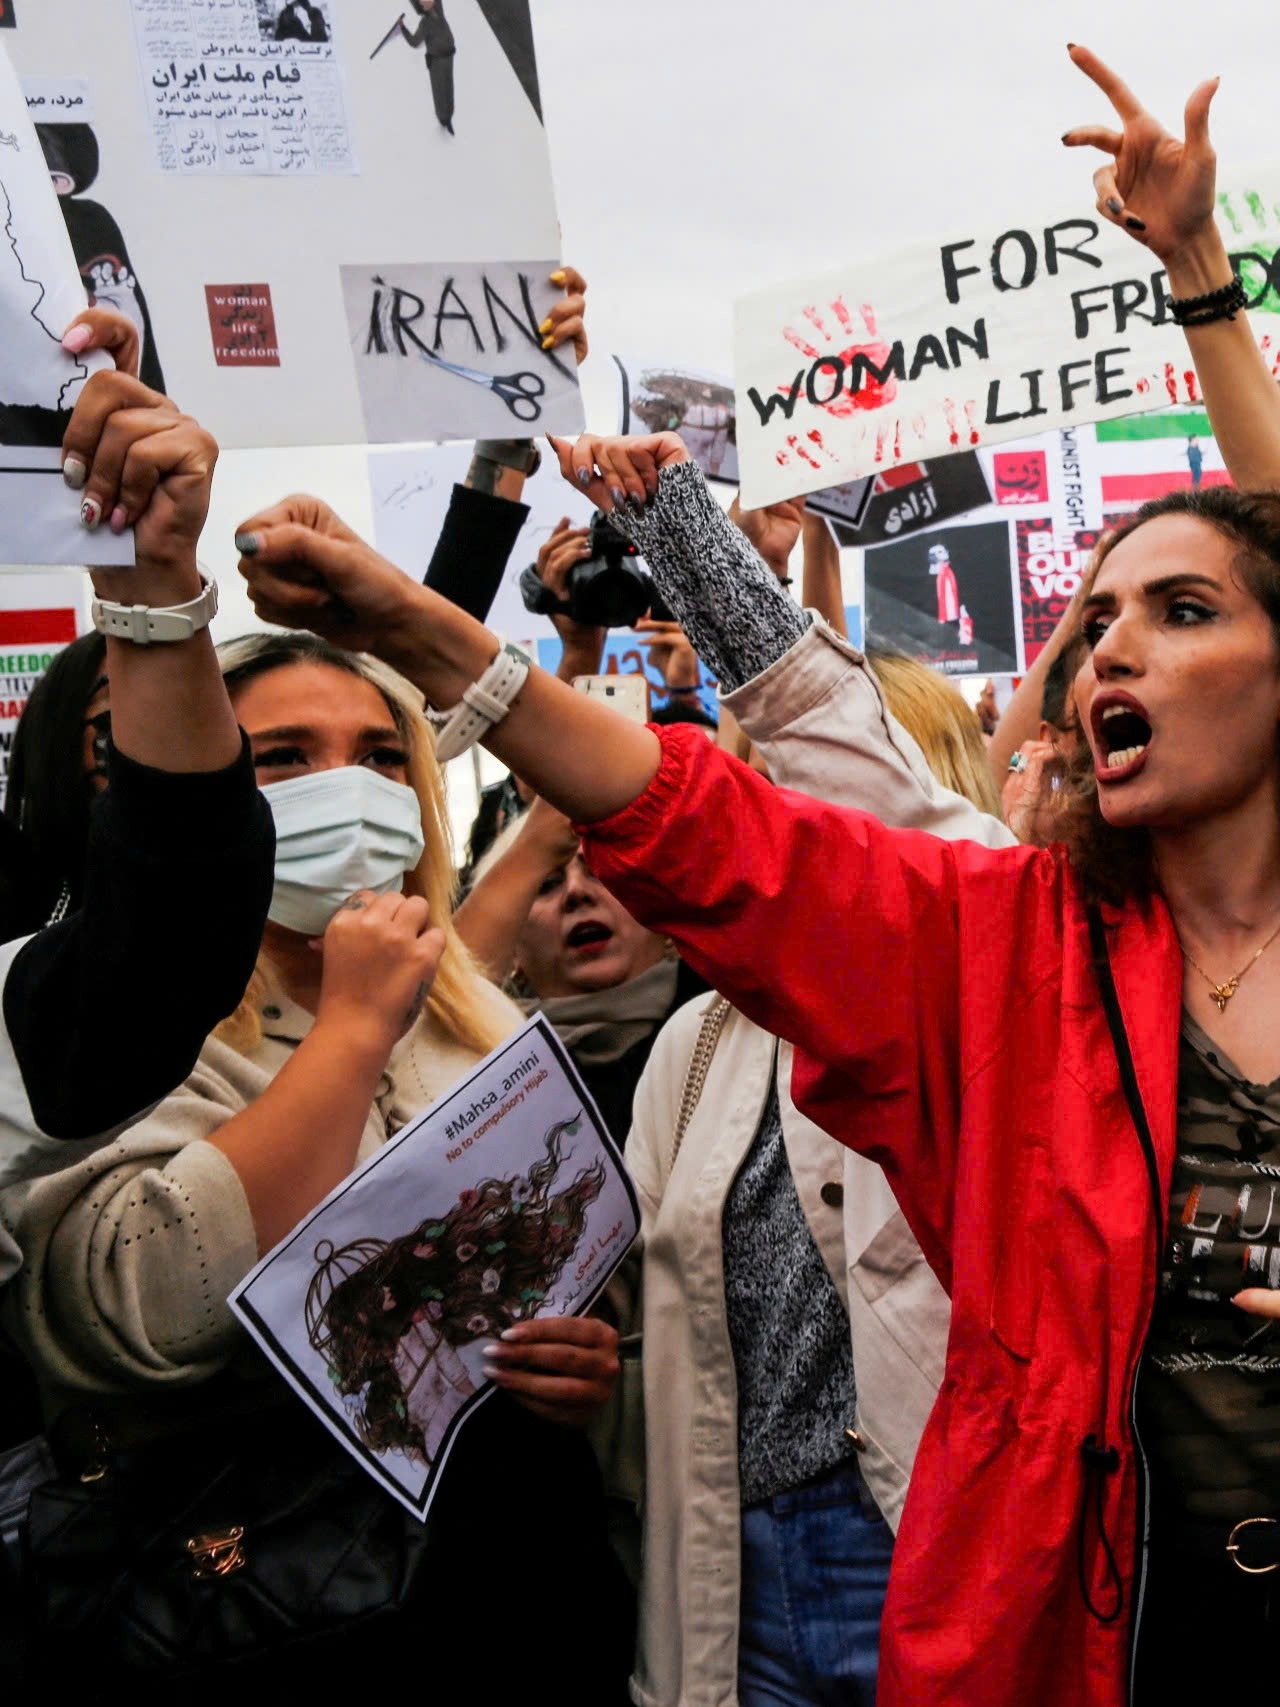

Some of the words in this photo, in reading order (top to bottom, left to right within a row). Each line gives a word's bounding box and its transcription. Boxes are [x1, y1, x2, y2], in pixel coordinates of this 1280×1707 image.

[152, 62, 207, 88] ایران
[213, 62, 256, 83] ملت
[262, 62, 301, 89] قیام
[940, 218, 1103, 304] FOR
[214, 296, 268, 306] woman
[747, 318, 989, 426] WOMAN
[985, 347, 1133, 424] LIFE
[884, 481, 938, 534] آزادی
[1064, 483, 1086, 528] FIGHT
[445, 1050, 541, 1141] #Mahsa_amini
[446, 1146, 463, 1163] No
[461, 1136, 474, 1149] to
[473, 1089, 526, 1140] compulsory
[523, 1068, 549, 1093] Hijab
